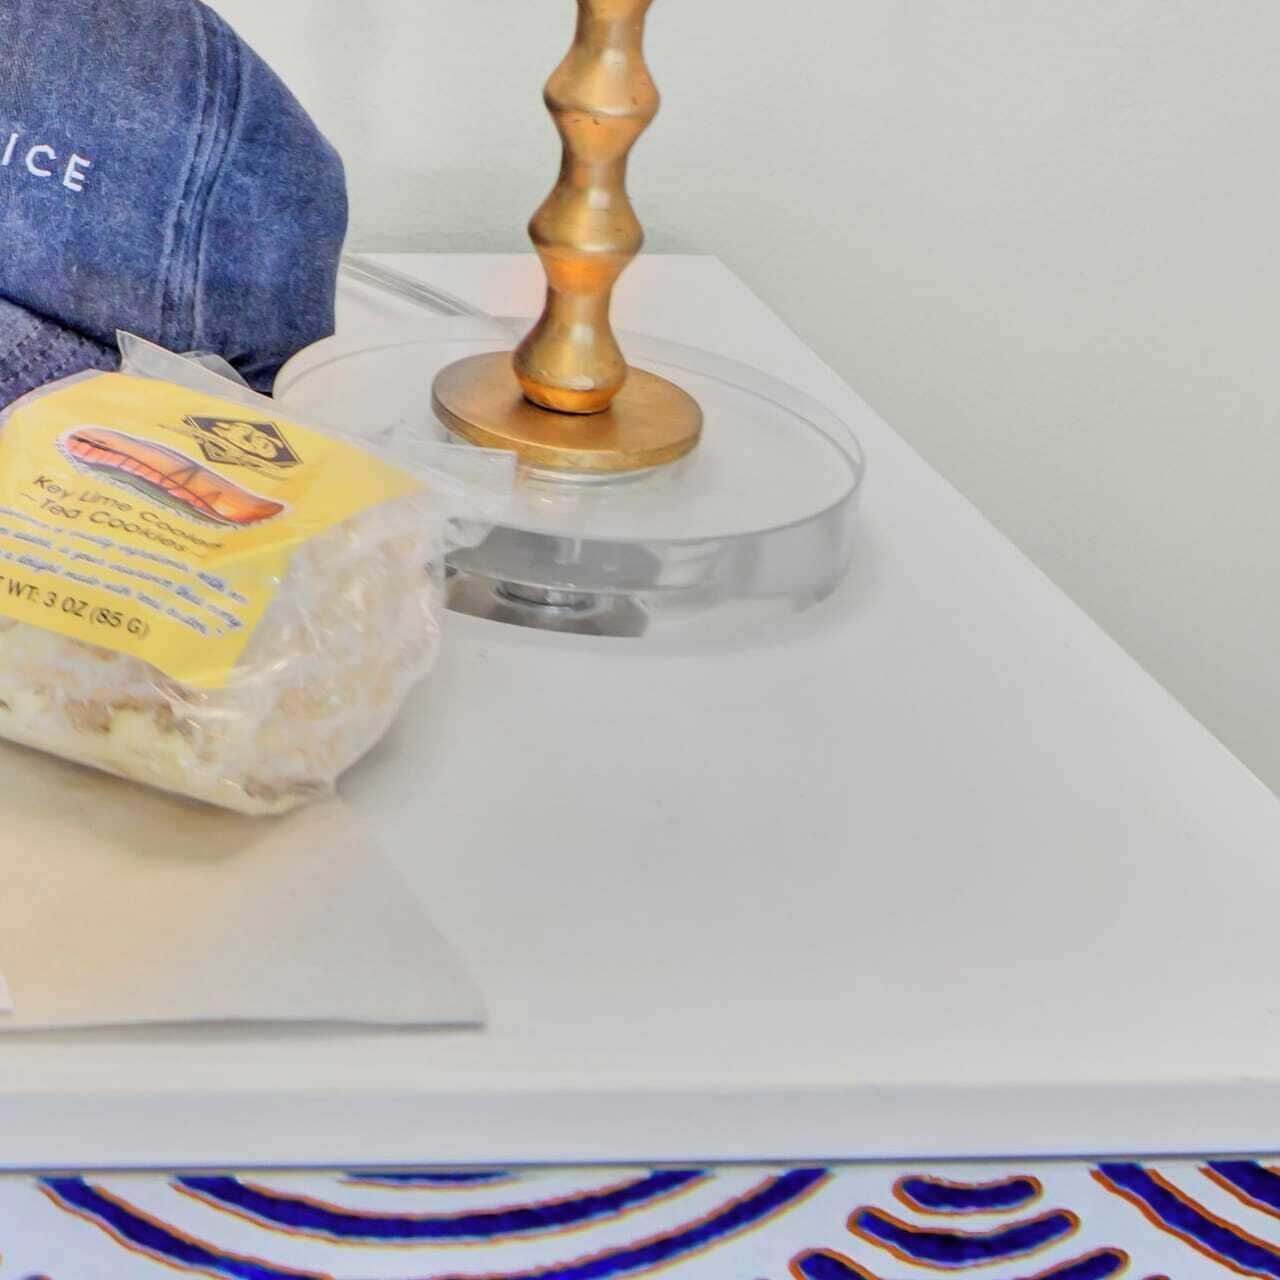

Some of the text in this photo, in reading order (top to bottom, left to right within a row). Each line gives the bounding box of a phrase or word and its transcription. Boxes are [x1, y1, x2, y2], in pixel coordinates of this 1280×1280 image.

[32, 474, 73, 503] Key
[78, 490, 133, 513] Lime
[39, 497, 188, 553] Tea Cookies
[42, 590, 58, 610] 3
[60, 594, 89, 619] OZ
